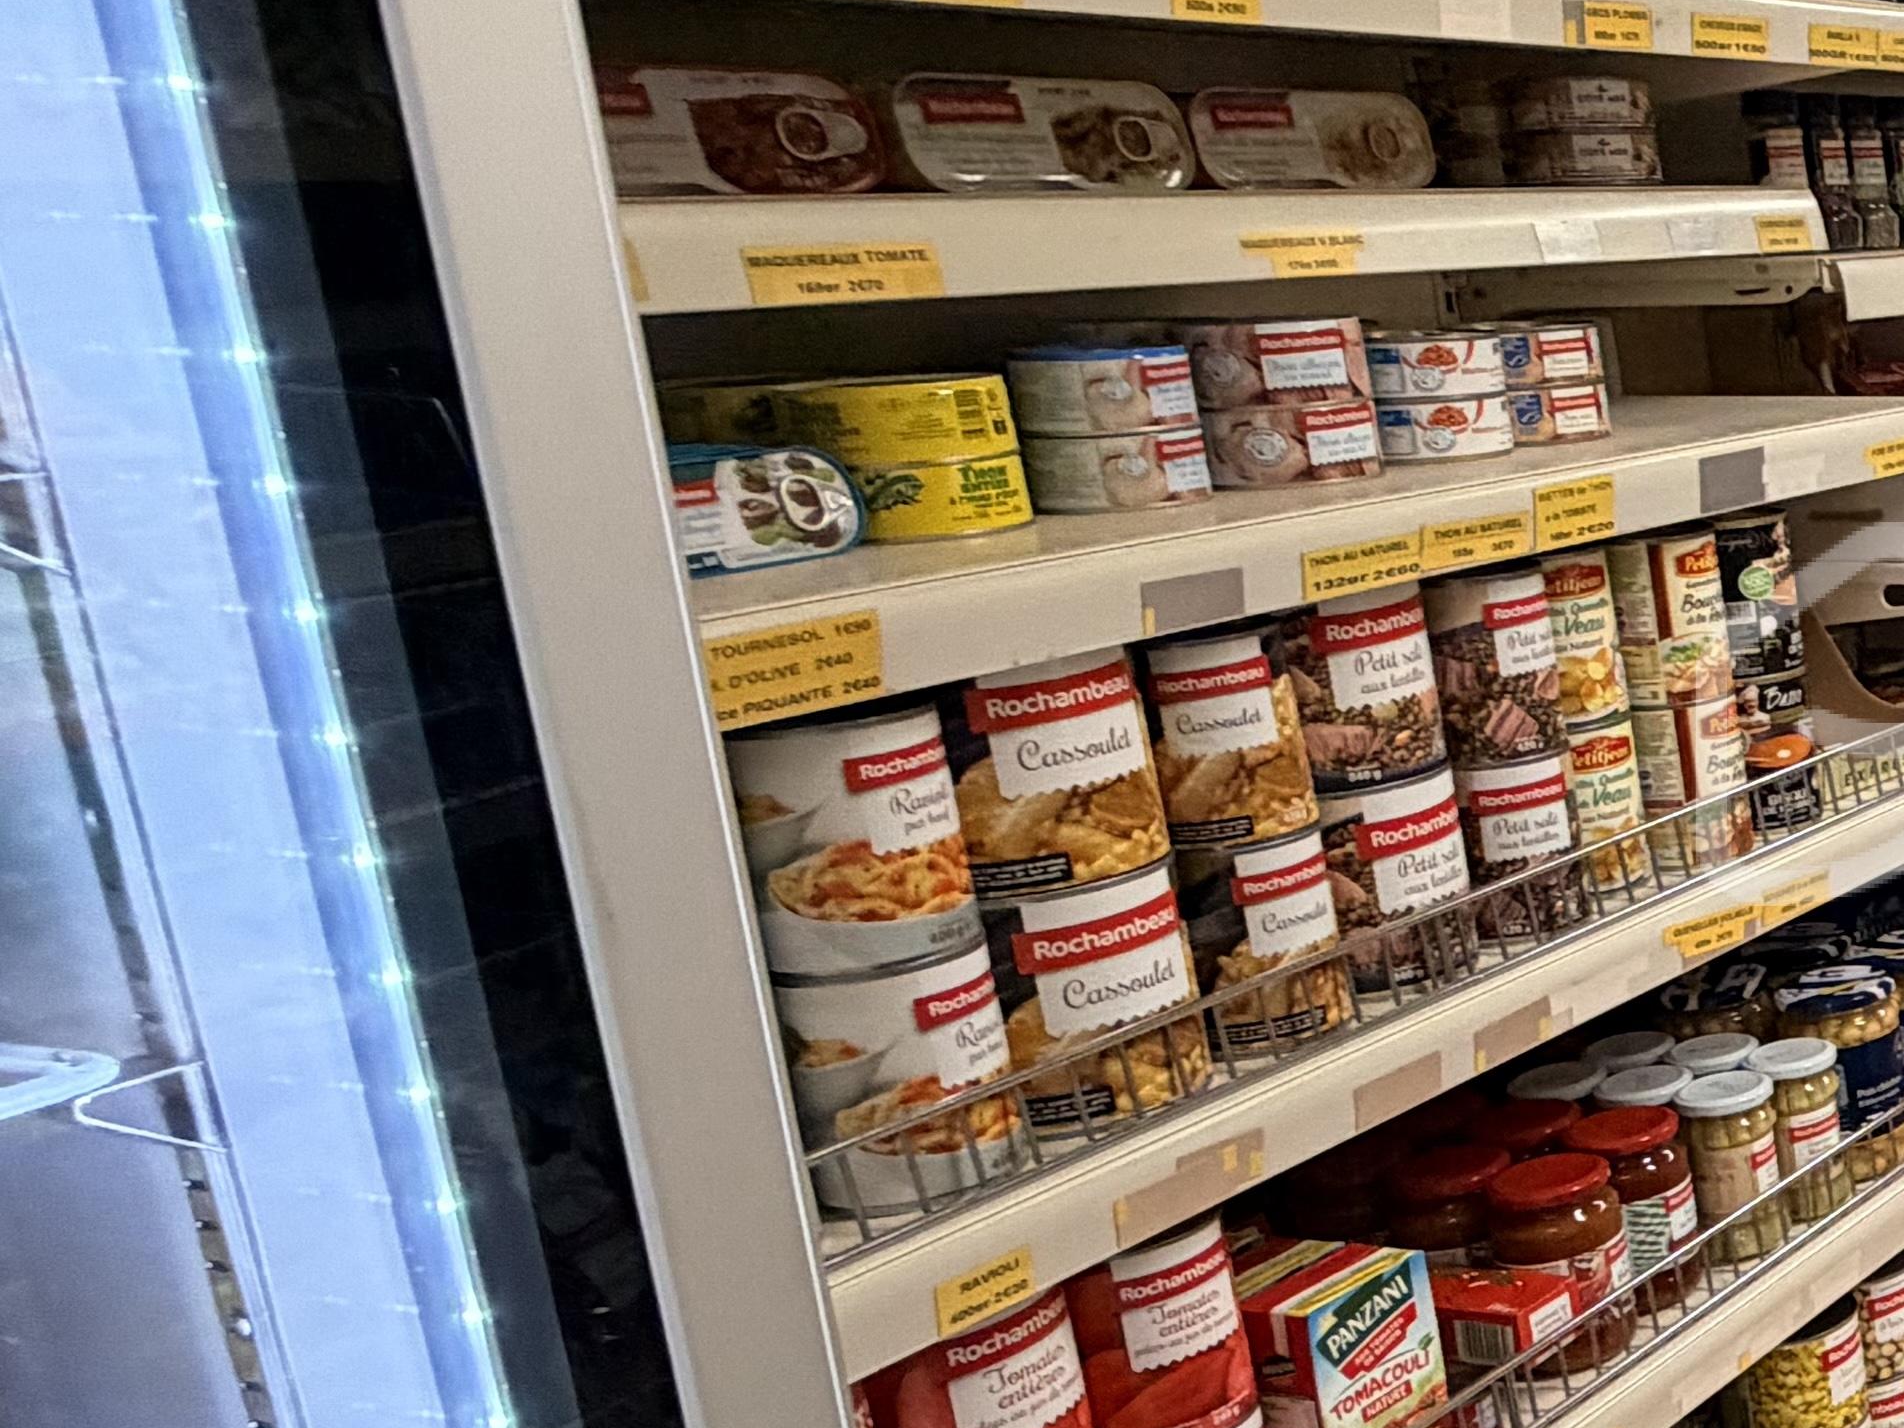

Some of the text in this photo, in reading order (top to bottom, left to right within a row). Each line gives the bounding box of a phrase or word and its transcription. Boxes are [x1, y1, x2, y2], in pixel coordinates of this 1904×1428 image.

[710, 624, 826, 661] TOURNESOL
[741, 686, 835, 717] PIQUANTE
[985, 673, 1132, 720] Rochambeau
[1156, 663, 1265, 695] Rochambeau
[1175, 707, 1263, 737] Cassoulet
[1016, 727, 1133, 773] Cassoulet
[1477, 781, 1567, 810] Rochambeau
[1032, 907, 1176, 961] Rochambeau
[1061, 962, 1176, 1011] Cassoulet
[1325, 1274, 1410, 1360] PANZANI
[1329, 1347, 1431, 1421] TOMACOULI
